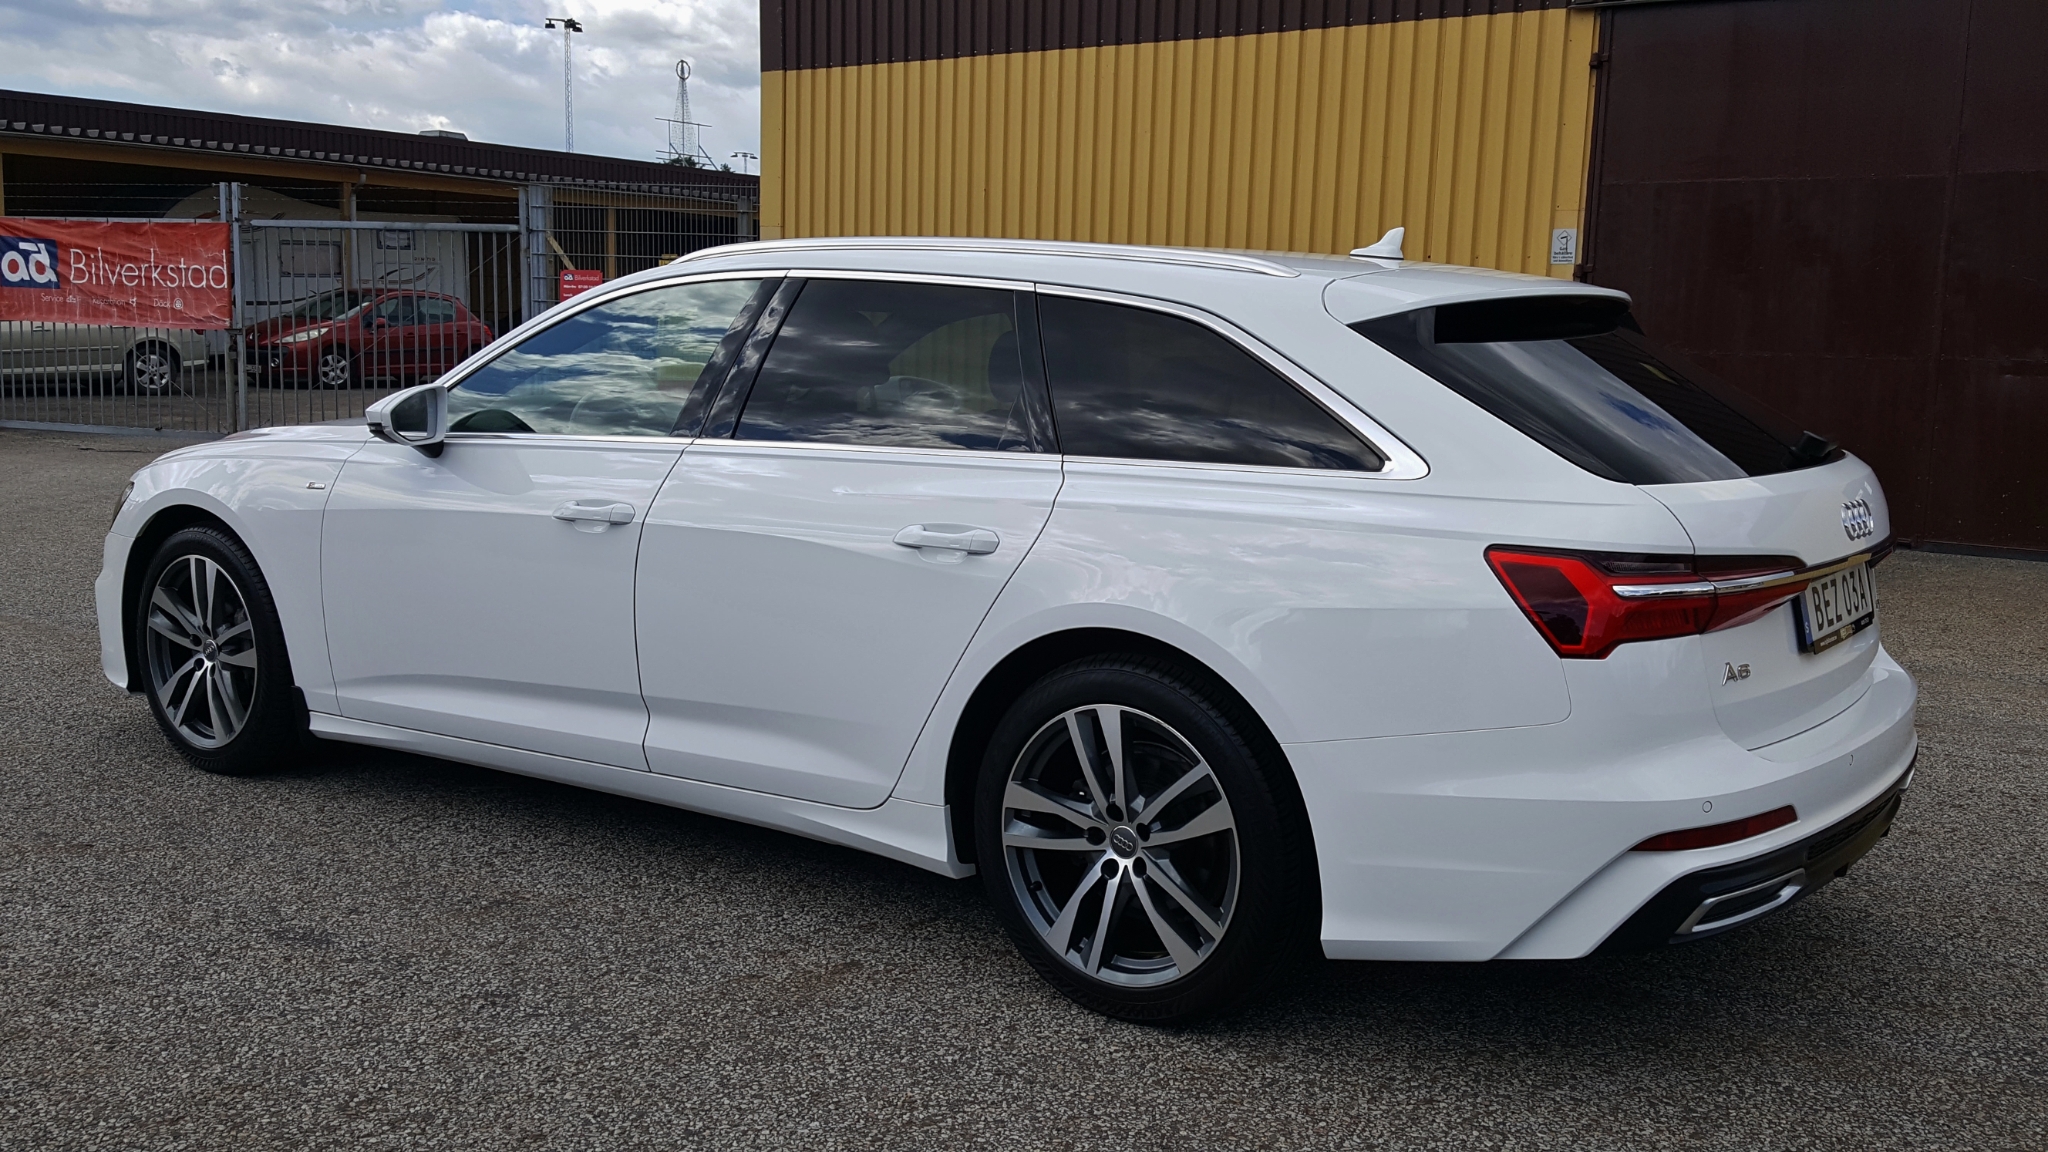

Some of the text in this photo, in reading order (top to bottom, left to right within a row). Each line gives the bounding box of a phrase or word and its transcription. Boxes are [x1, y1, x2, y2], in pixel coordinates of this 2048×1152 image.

[69, 247, 228, 289] Bilverkstad
[40, 292, 64, 303] Service
[153, 298, 170, 308] Däck
[1811, 568, 1868, 632] BEZ 03A
[1804, 622, 1811, 634] S
[1722, 661, 1751, 687] A6
